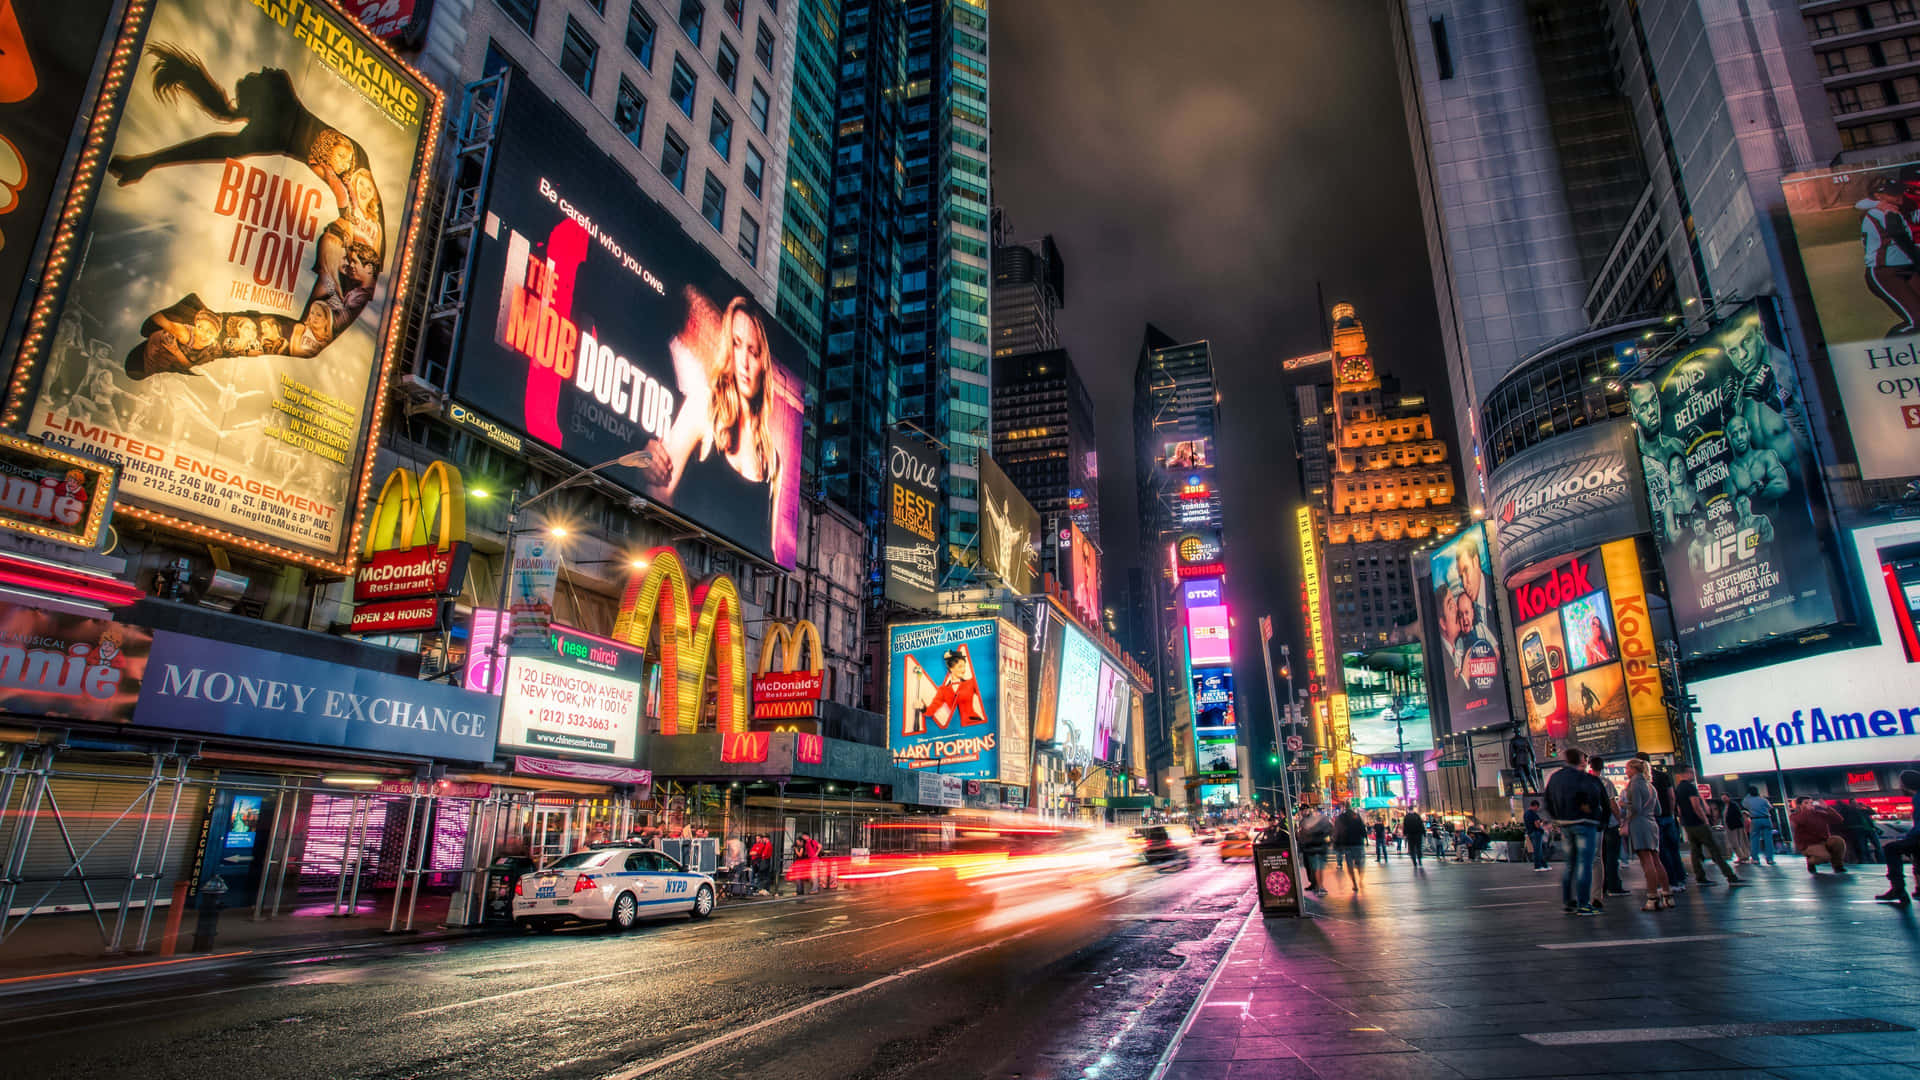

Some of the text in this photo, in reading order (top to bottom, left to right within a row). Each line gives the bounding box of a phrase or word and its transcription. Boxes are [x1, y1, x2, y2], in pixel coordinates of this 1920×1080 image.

[214, 157, 322, 243] BRING
[540, 177, 666, 297] Be careful who you owe.
[228, 223, 305, 293] IT ON
[527, 253, 559, 304] THE
[230, 279, 297, 312] THE MUSICAL
[505, 282, 675, 443] MOB DOCTOR
[1863, 341, 1920, 370] Hel
[283, 387, 300, 404] Tony
[1675, 367, 1706, 397] JONES
[272, 399, 304, 418] creators
[304, 412, 313, 423] of
[313, 413, 343, 434] AVENUE
[573, 397, 635, 443] MONDAY
[1674, 387, 1719, 432] BELFORT
[281, 431, 303, 449] NEXT
[304, 439, 315, 452] TO
[314, 443, 345, 465] NORMAL
[290, 419, 350, 452] IN THE HEIGHTS
[45, 412, 337, 519] LIMITED ENGAGEMENT
[1686, 437, 1729, 472] BENAVIDEZ
[79, 441, 123, 465] JAMES
[179, 474, 201, 490] 246
[204, 481, 218, 496] W.
[242, 494, 256, 508] ST.
[1695, 463, 1730, 493] JOHNSON
[143, 477, 221, 509] 212.239.6200
[230, 503, 332, 543] BringItOnMusical.com
[893, 483, 936, 525] BEST
[1529, 484, 1626, 519] driving emotion
[1707, 500, 1733, 521] BISPING
[892, 504, 934, 534] MUSICAL
[1300, 512, 1309, 534] THE
[1060, 540, 1071, 548] LG
[1190, 552, 1214, 561] 2012
[1303, 541, 1313, 566] NEW
[1703, 527, 1760, 574] UFC 152
[358, 558, 448, 582] McDonald's
[369, 578, 429, 593] Restaurant
[1178, 564, 1225, 577] TOSHIBA
[1307, 573, 1317, 595] HTC
[1716, 565, 1760, 591] SEPTEMBER
[1759, 561, 1771, 576] 22
[1196, 589, 1217, 599] TDK
[1515, 558, 1594, 622] Kodak
[1700, 593, 1716, 609] LIVE
[1715, 590, 1726, 604] ON
[1725, 570, 1780, 601] PAY-PER-VIEW
[353, 607, 433, 624] OPEN 24 HOURS
[907, 625, 944, 640] EVERYTHING
[947, 629, 964, 642] AND
[966, 623, 993, 640] MORE!
[1614, 595, 1657, 698] Kodak
[589, 647, 618, 666] mirch
[518, 666, 633, 703] 120 LEXINGTON AVENUE
[520, 683, 628, 715] NEW YORK, NY 10016
[756, 679, 819, 692] McDonald's
[765, 690, 808, 699] Restaurant
[156, 663, 487, 739] MONEY EXCHANGE
[539, 709, 610, 730] (212) 532-3663
[1705, 716, 1773, 755] Bank
[1775, 709, 1806, 747] of
[893, 742, 932, 764] MARY
[934, 732, 996, 757] POPPINS
[190, 819, 209, 897] EXCHANGE
[664, 879, 689, 894] NYPD
